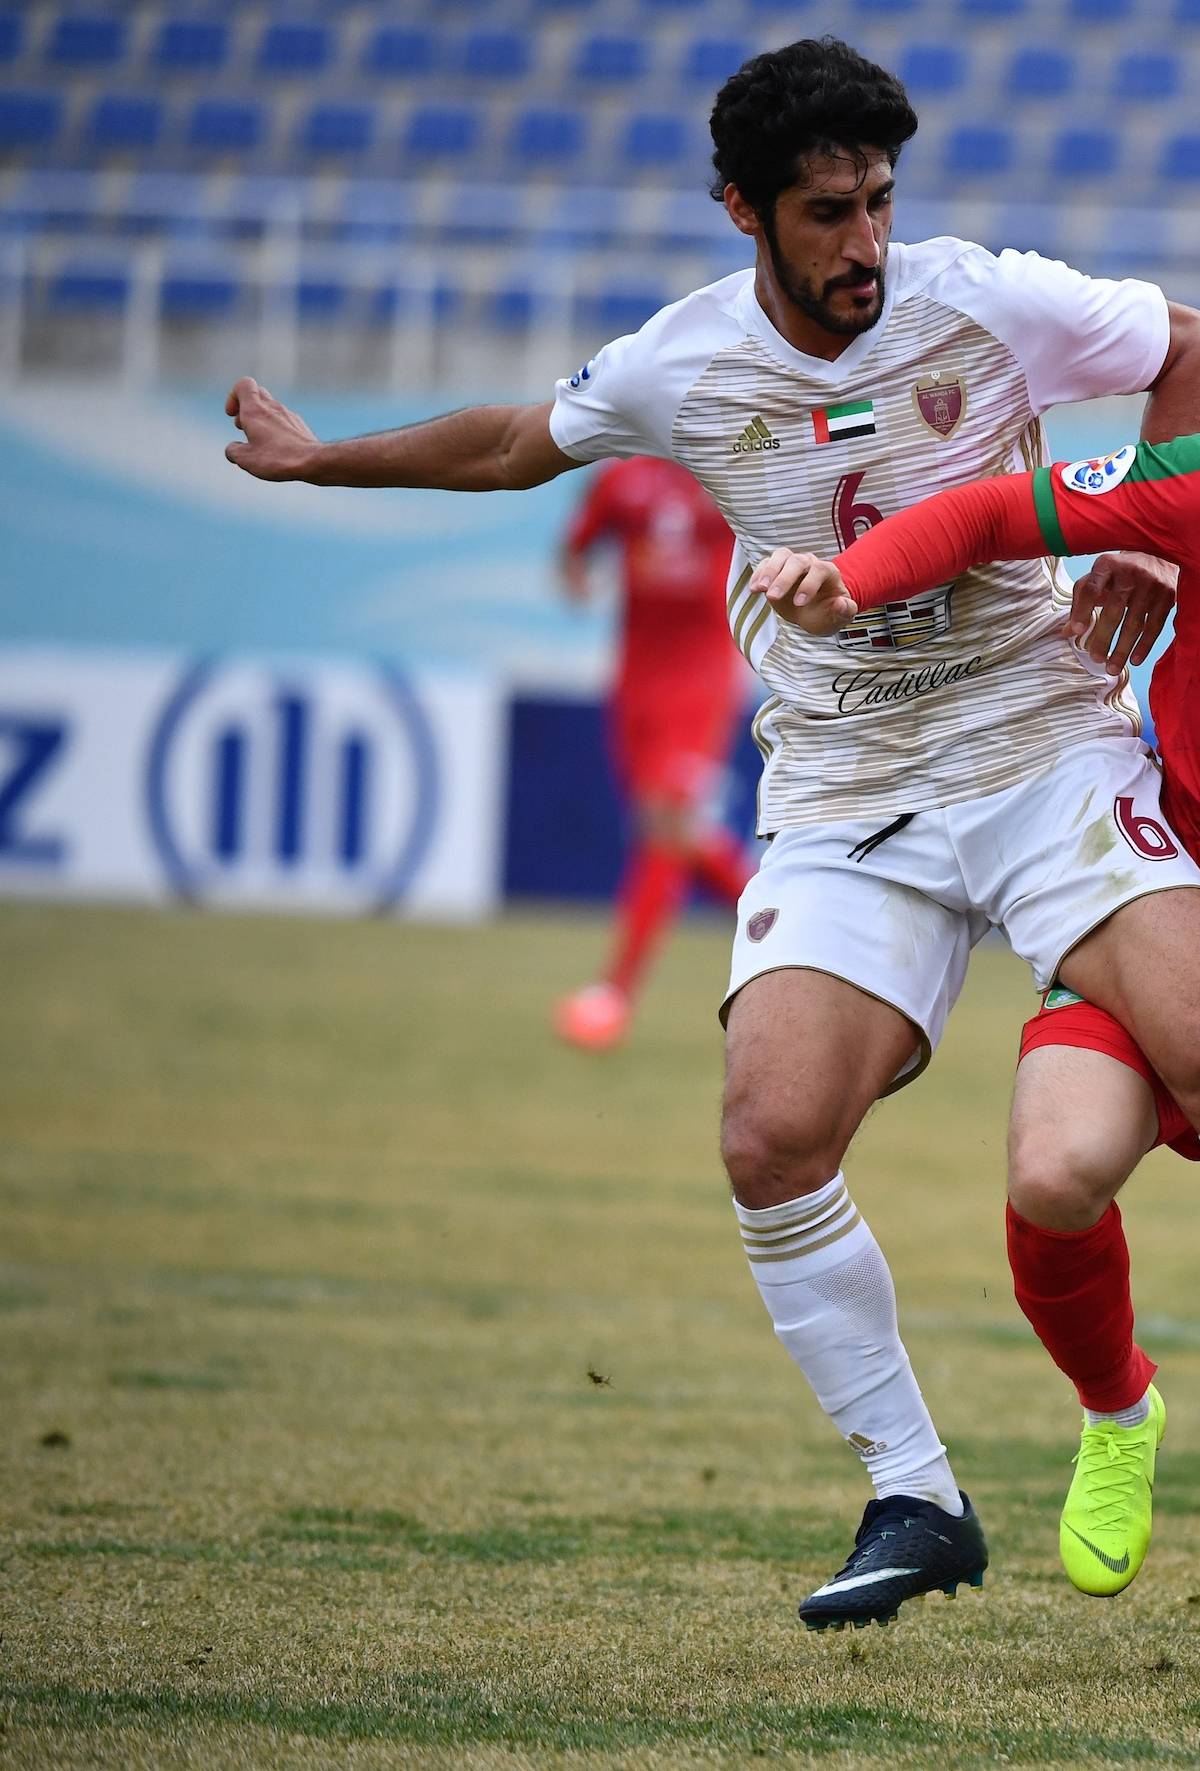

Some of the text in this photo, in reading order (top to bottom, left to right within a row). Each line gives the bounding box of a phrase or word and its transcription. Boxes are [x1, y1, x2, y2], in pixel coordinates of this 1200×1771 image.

[733, 439, 780, 452] adidas
[832, 471, 884, 553] 6
[832, 656, 982, 714] Cadillac
[1113, 796, 1179, 862] 6
